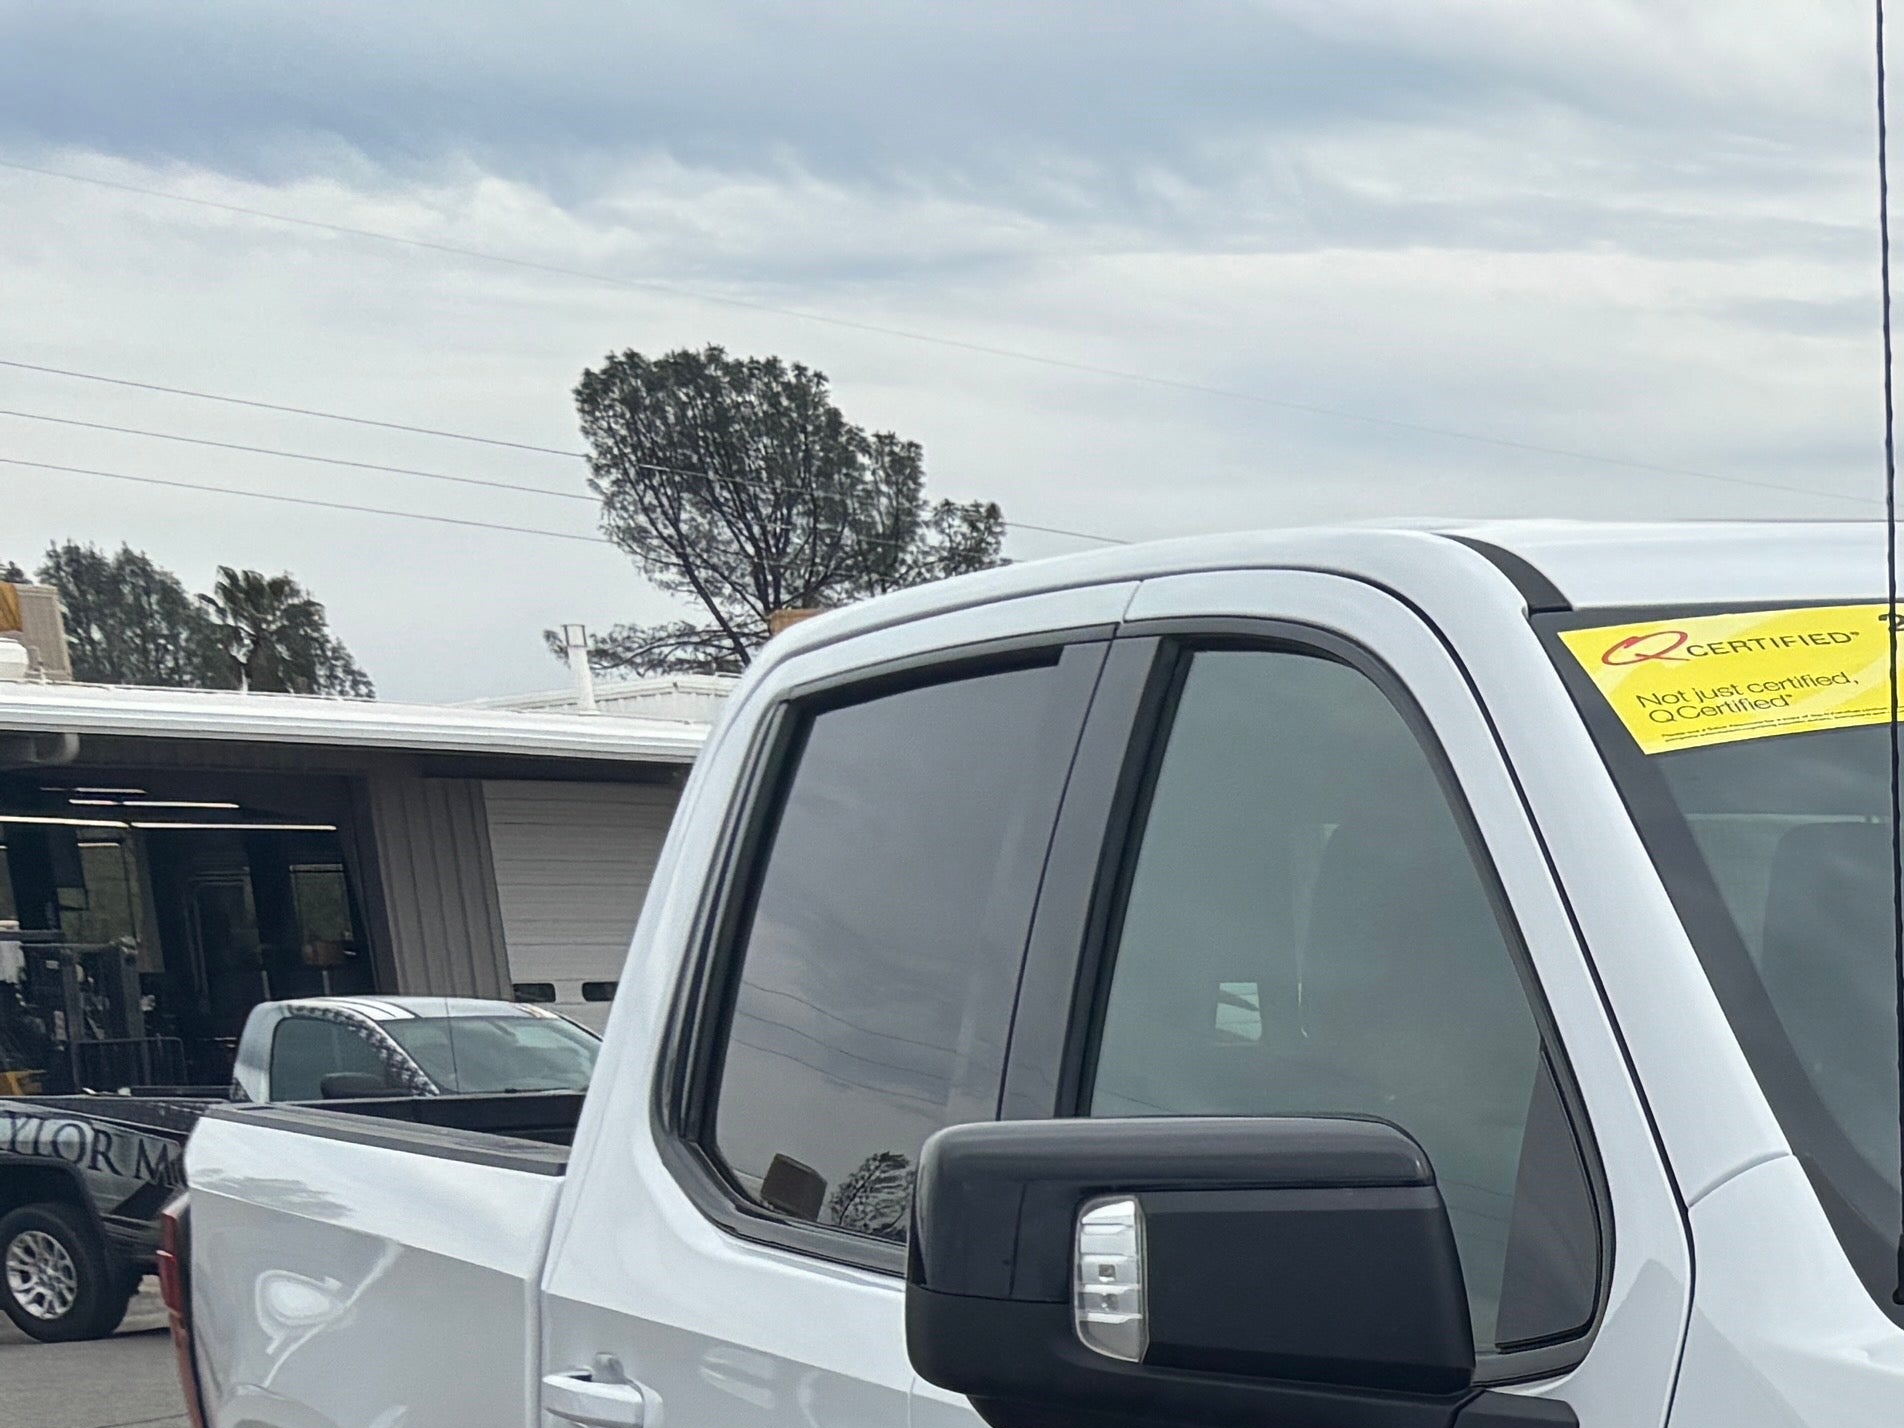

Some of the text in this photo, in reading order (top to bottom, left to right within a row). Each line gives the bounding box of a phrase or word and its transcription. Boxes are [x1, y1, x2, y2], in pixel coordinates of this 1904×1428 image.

[1636, 671, 1859, 708] Not just certified,
[0, 1110, 124, 1177] YLOR
